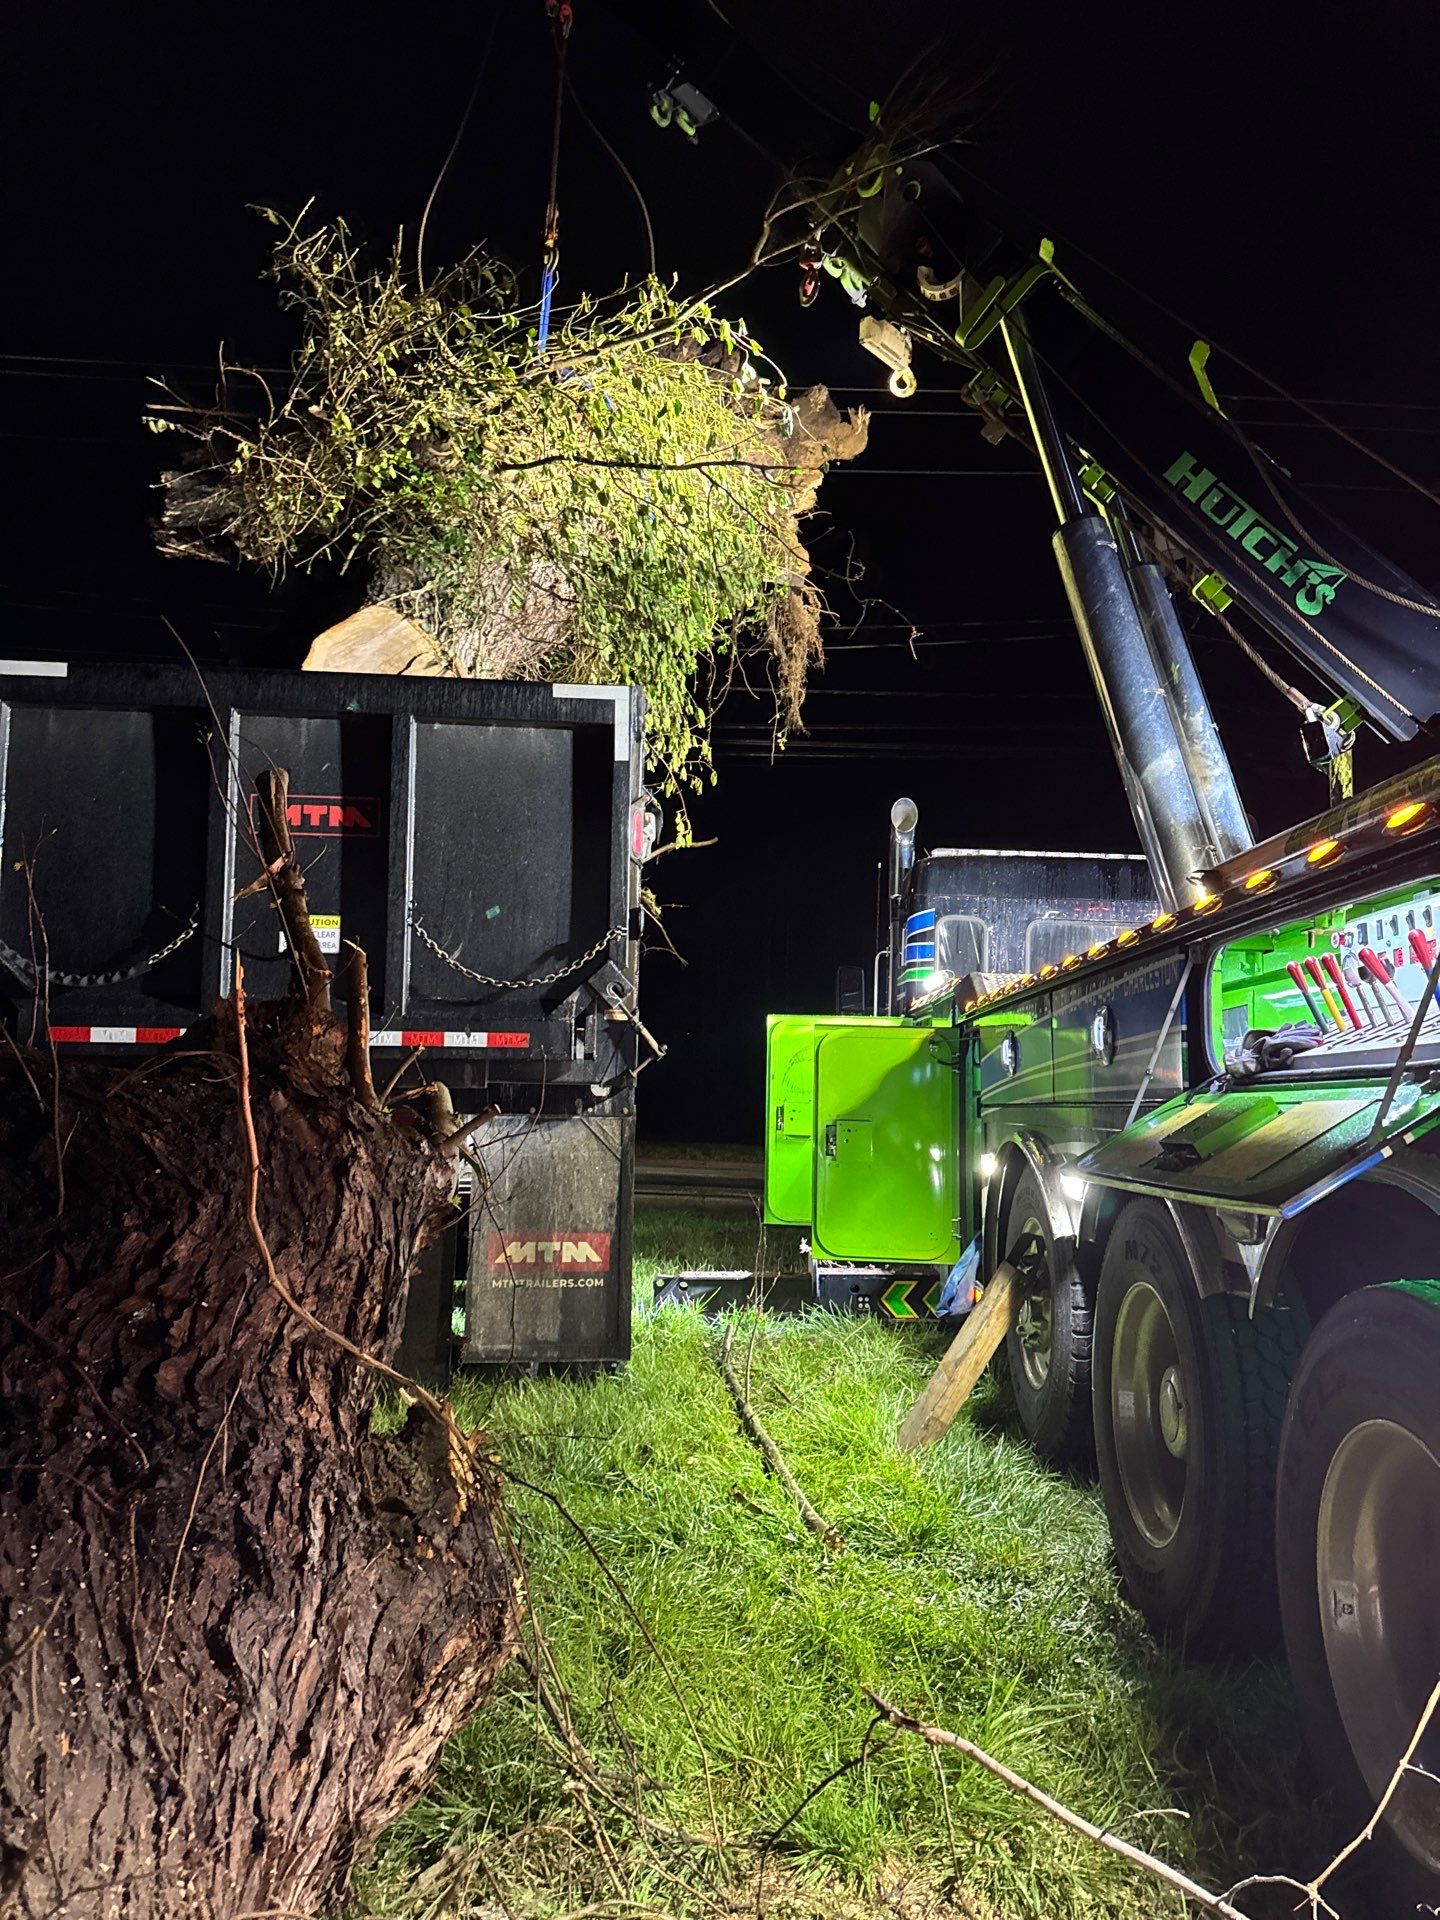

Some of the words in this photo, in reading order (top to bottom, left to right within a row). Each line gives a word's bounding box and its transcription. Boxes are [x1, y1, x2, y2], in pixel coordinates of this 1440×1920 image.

[310, 918, 339, 926] UTION
[494, 1241, 603, 1264] MTM
[492, 1278, 604, 1288] MTMTRAILERS.COM
